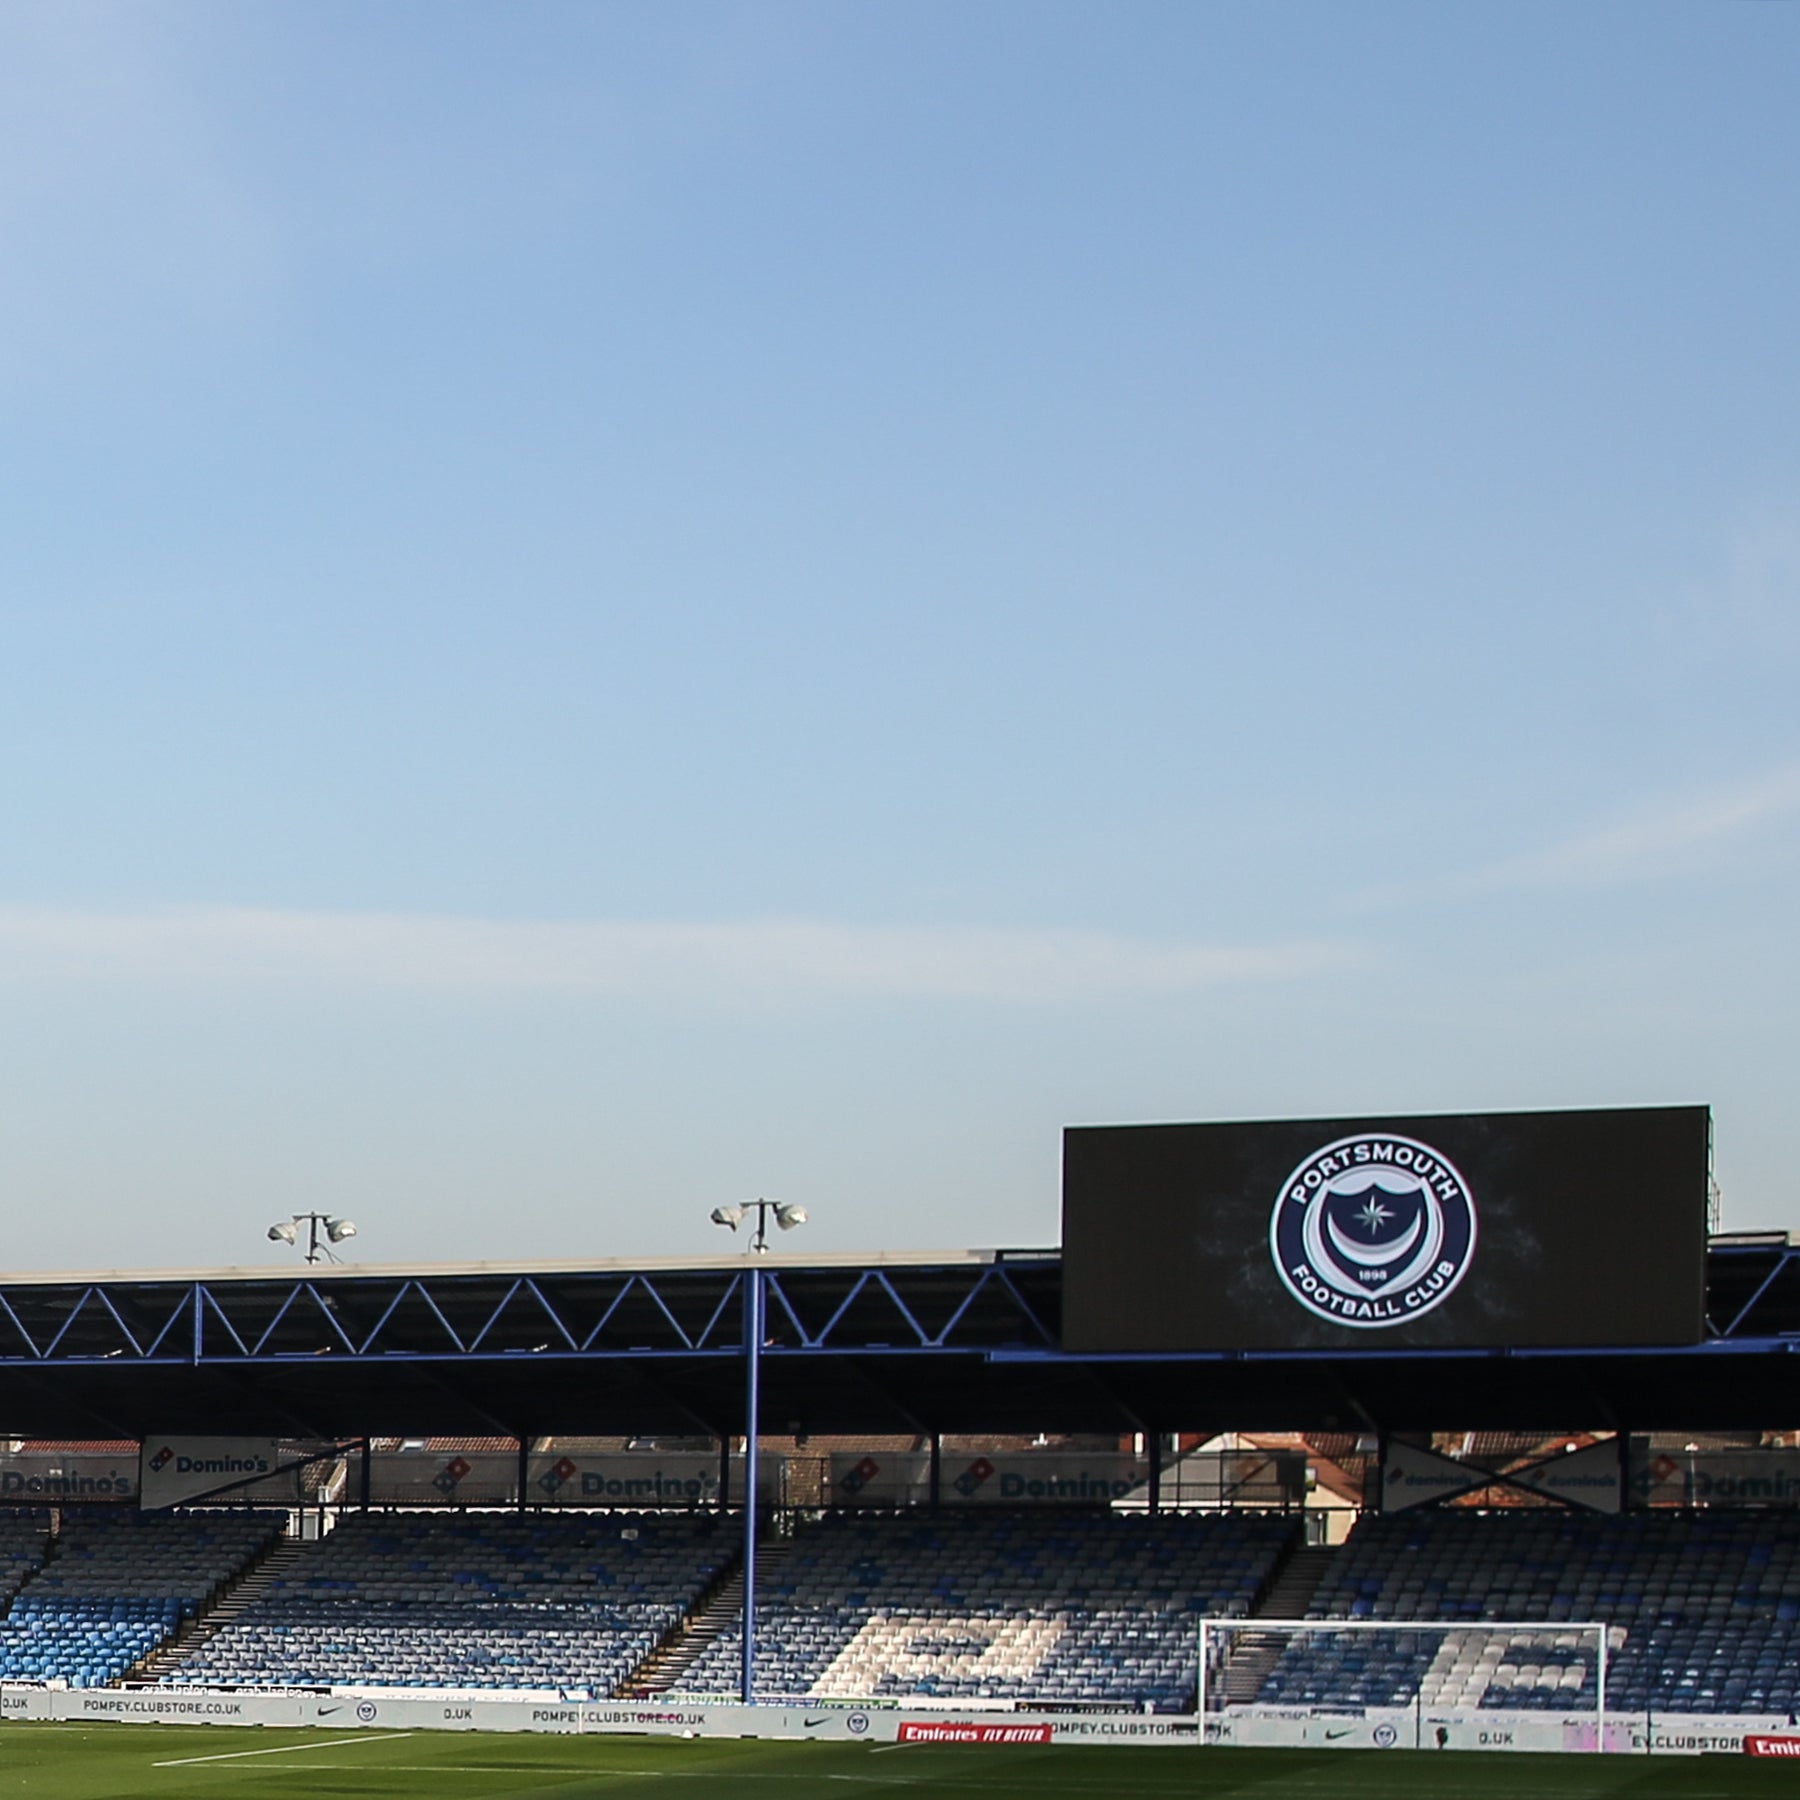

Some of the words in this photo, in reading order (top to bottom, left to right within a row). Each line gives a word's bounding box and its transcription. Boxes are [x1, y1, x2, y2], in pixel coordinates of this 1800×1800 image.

[1290, 1141, 1460, 1207] PORTSMOUTH
[1358, 1268, 1387, 1282] 1898
[1290, 1263, 1402, 1319] FOOTBALL
[1403, 1259, 1458, 1310] CLUB
[176, 1454, 269, 1474] Domino's
[2, 1470, 130, 1494] Domino's
[84, 1700, 242, 1715] POMPEY.CLUBSTORE.CO.UK
[533, 1710, 706, 1725] POMPEY.CLUBSTORE.CO.UK
[905, 1727, 979, 1741] Emirates
[982, 1728, 998, 1741] FLY
[998, 1728, 1045, 1742] BETTER
